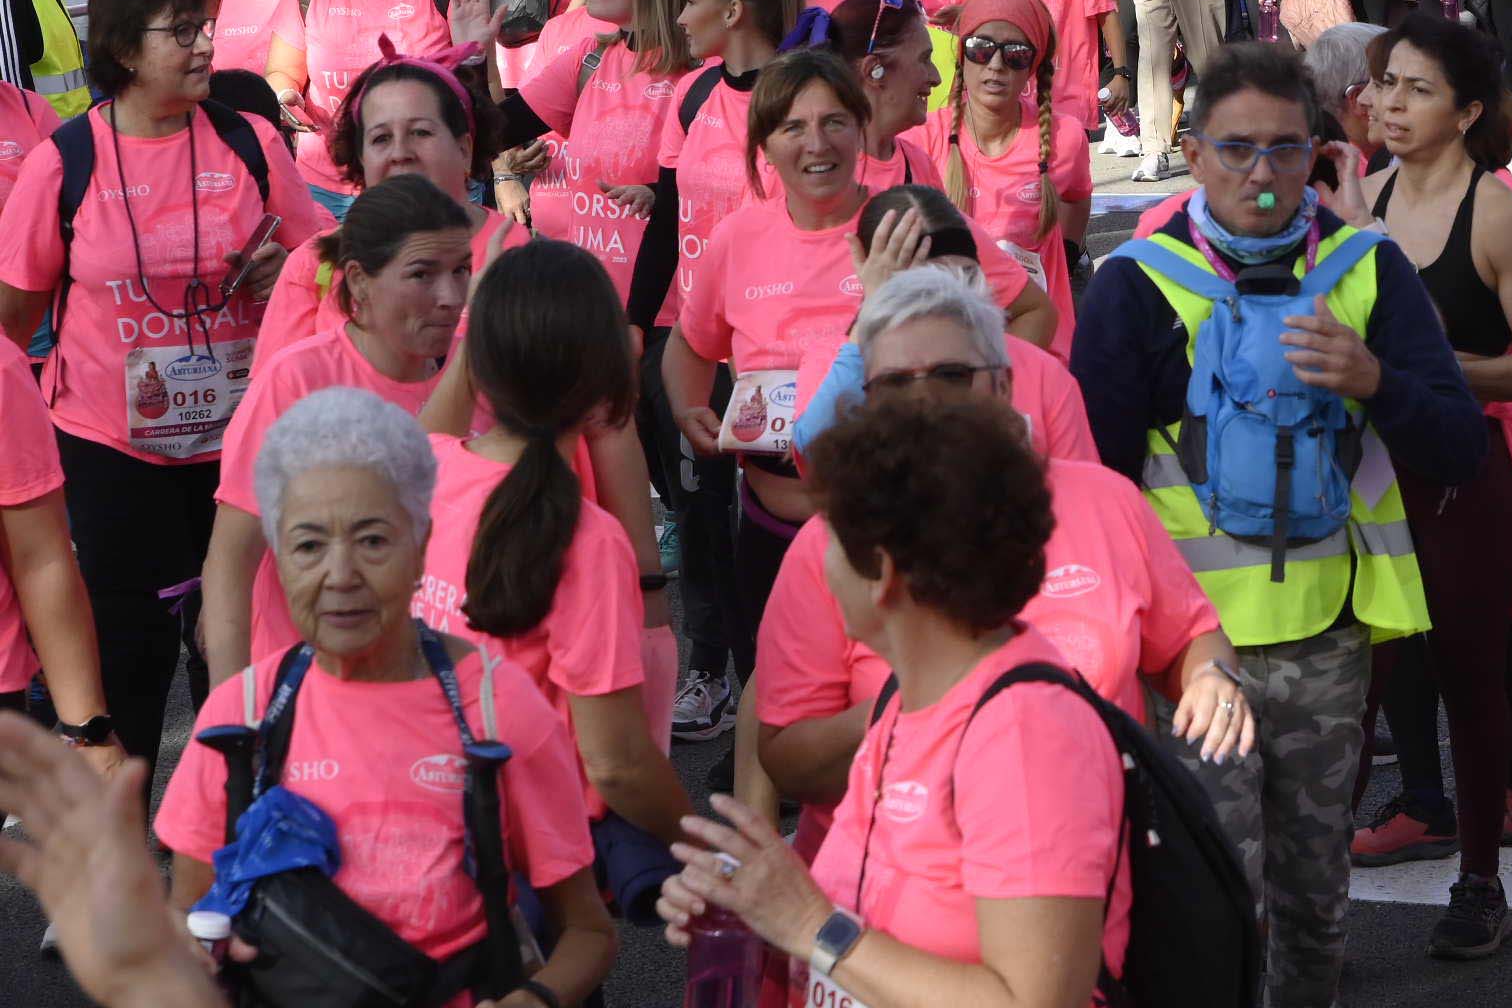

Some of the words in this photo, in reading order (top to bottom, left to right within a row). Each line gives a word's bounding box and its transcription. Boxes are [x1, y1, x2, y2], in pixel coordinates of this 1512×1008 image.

[321, 70, 350, 89] TU
[573, 225, 625, 255] UMA
[104, 275, 149, 306] TU
[744, 281, 794, 300] OYSHO
[116, 300, 250, 343] DORSAL
[172, 388, 217, 407] 016
[179, 408, 212, 422] 10262
[289, 760, 340, 783] SHO
[813, 981, 853, 1008] 016
